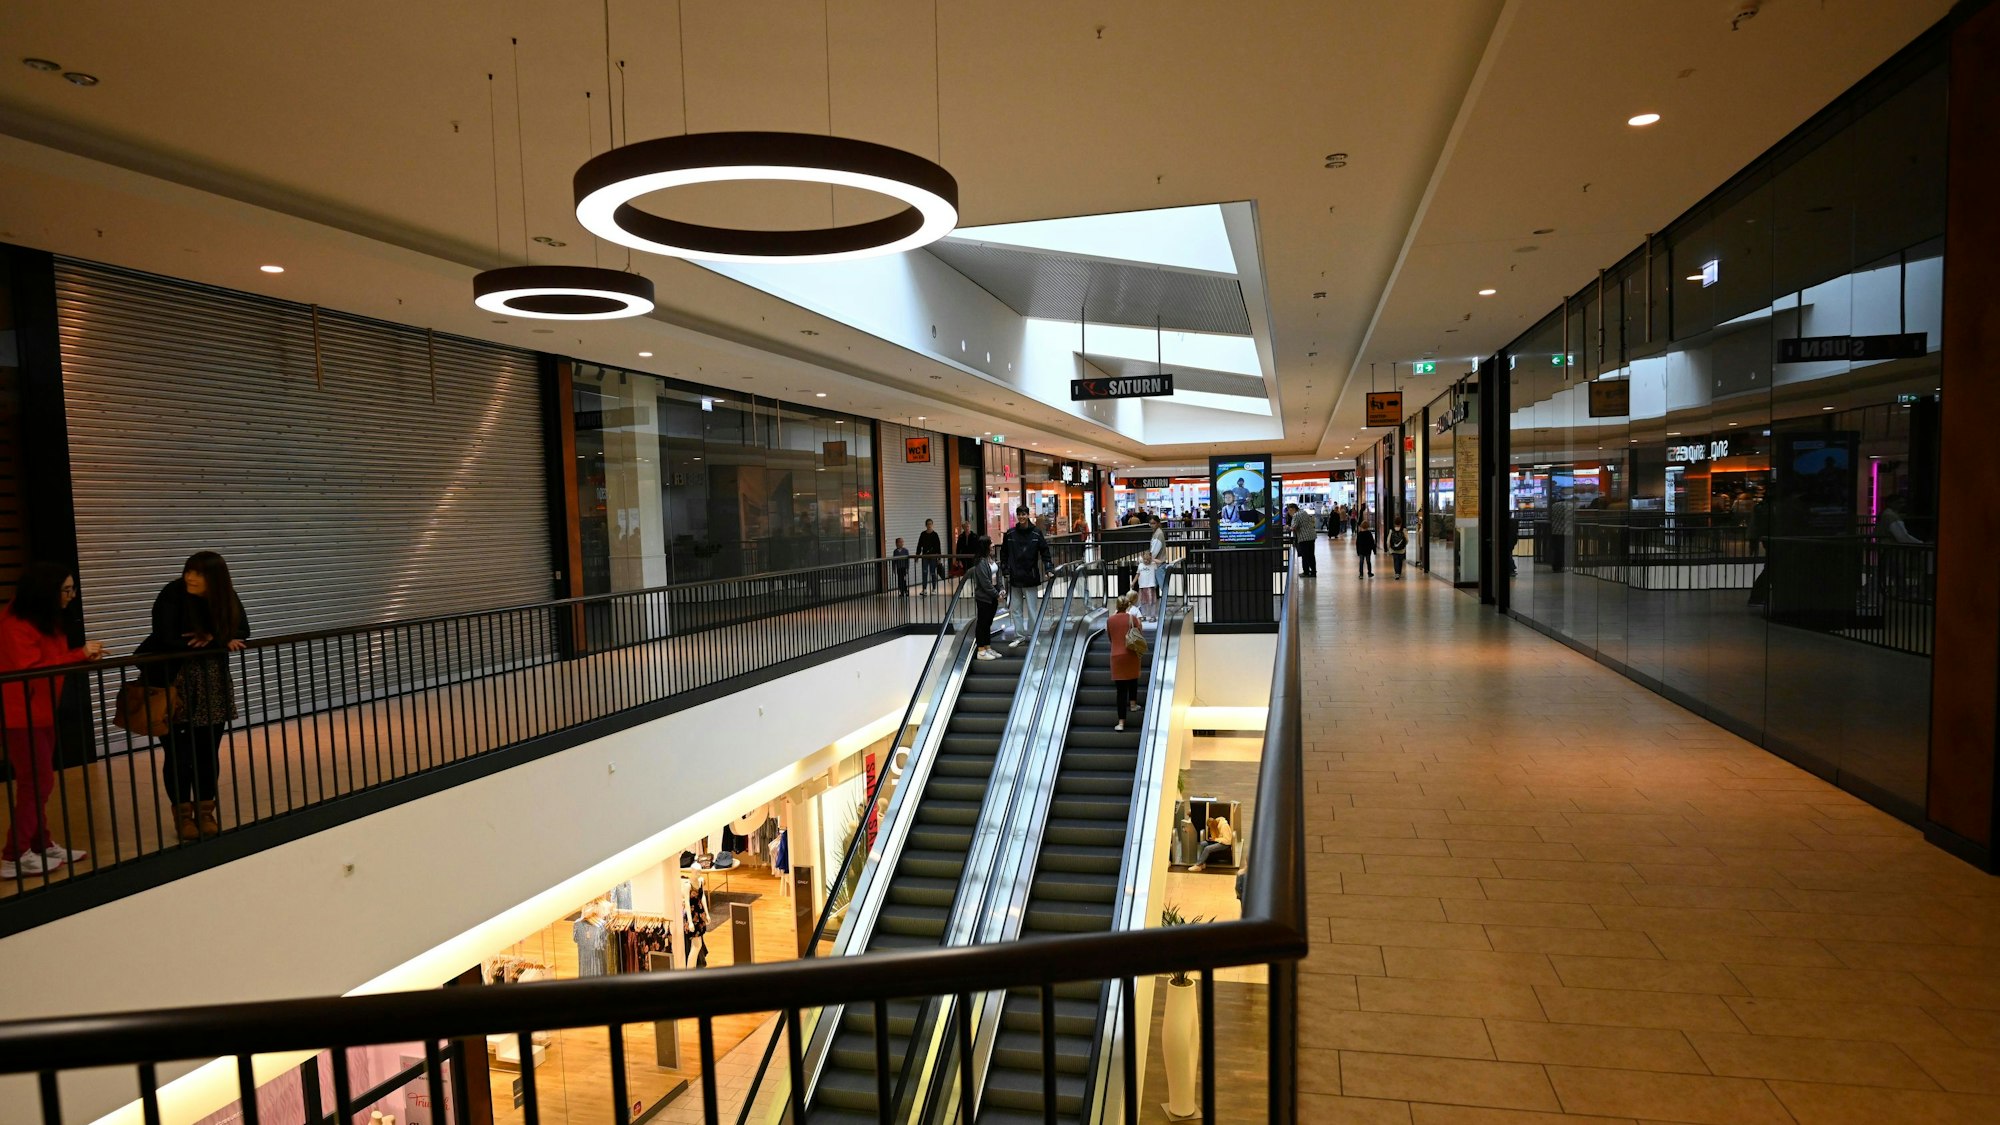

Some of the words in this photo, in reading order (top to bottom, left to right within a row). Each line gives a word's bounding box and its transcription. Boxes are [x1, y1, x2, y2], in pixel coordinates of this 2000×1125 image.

[1108, 378, 1161, 396] SATURN
[909, 447, 920, 455] WC
[1142, 478, 1168, 488] SATURN
